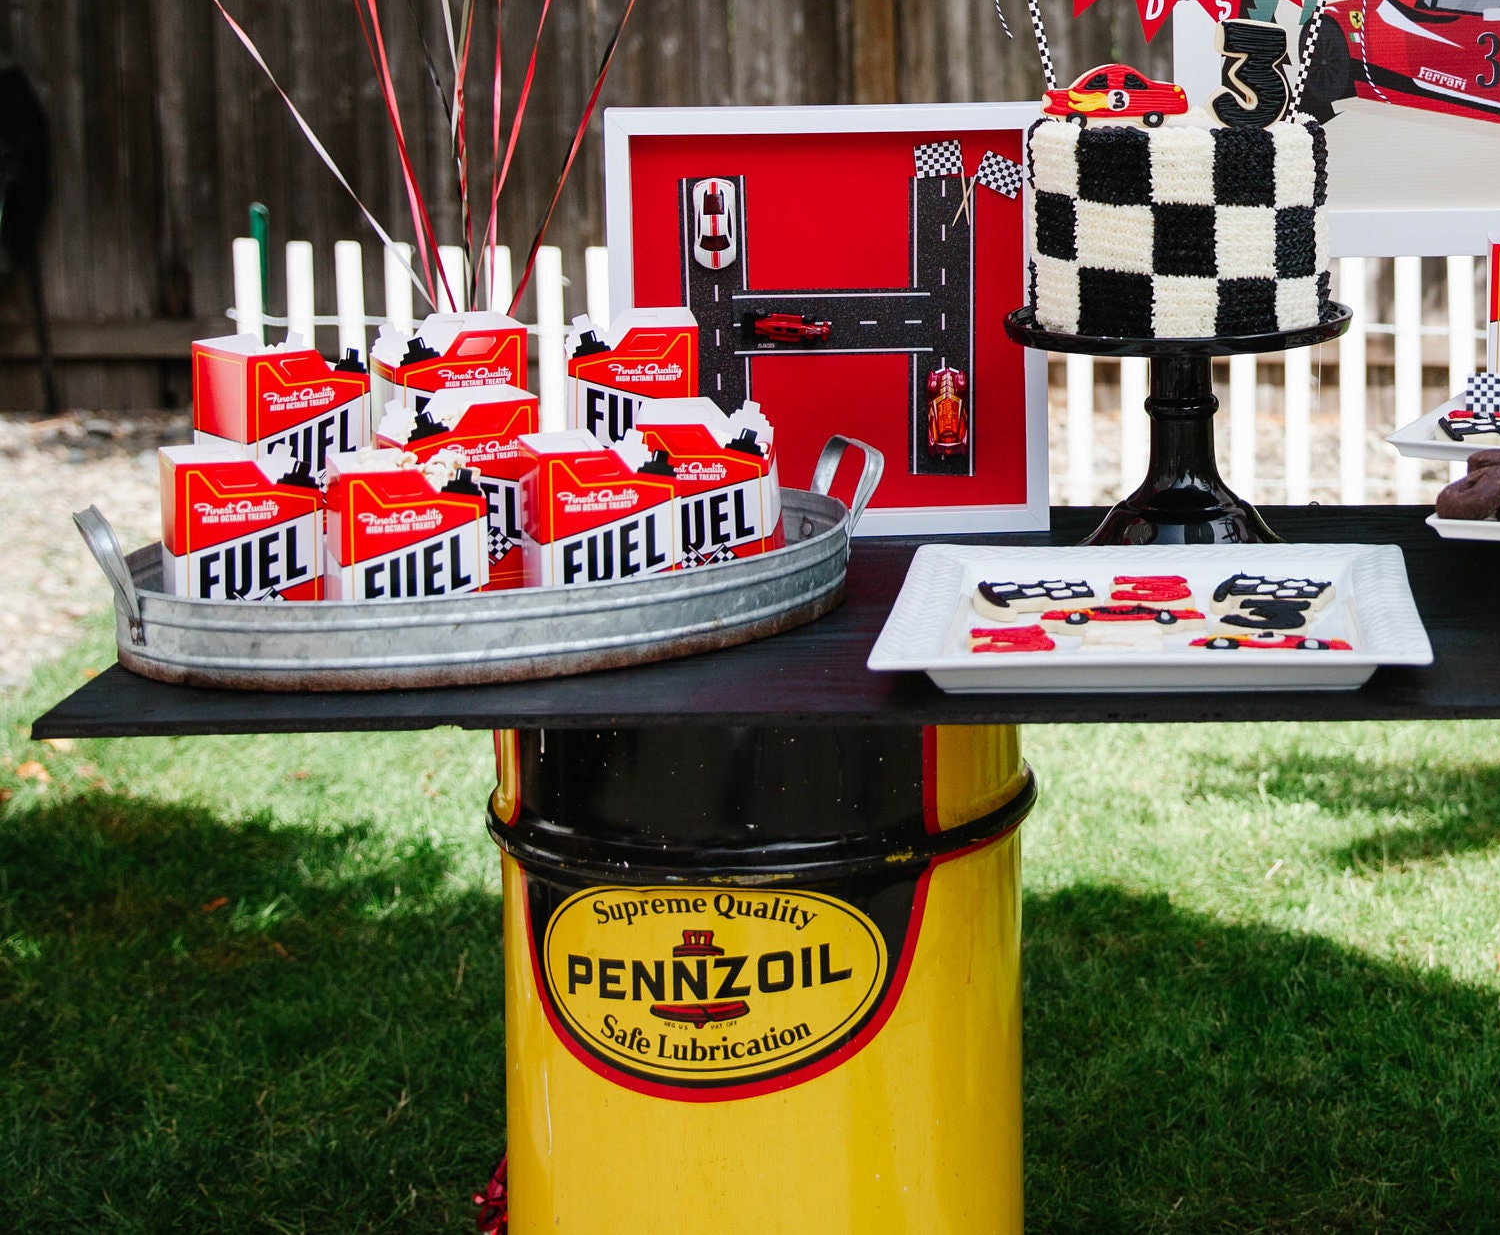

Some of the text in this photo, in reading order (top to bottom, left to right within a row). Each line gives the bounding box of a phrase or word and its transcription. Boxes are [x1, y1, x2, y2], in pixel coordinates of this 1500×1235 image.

[1206, 19, 1288, 129] 3
[1417, 66, 1467, 91] Ferrari
[1111, 90, 1128, 109] 3
[438, 367, 512, 381] Finest Quality
[608, 363, 683, 378] Finest Quality
[263, 386, 336, 403] Finest Quality
[587, 387, 642, 444] FU
[267, 409, 356, 473] UEL
[447, 439, 519, 456] Finest Qualit
[688, 462, 727, 478] Quality
[194, 500, 280, 516] Finest Quality
[557, 488, 639, 505] Finest Quality
[357, 508, 443, 525] Finest Quality
[681, 488, 755, 552] UEL
[200, 525, 307, 600] FUEL
[564, 513, 666, 584] FUEL
[365, 534, 471, 599] FUEL
[592, 892, 818, 931] Supreme Quality
[566, 942, 853, 1002] PENNZOIL
[600, 1013, 813, 1062] Safe Lubrication
